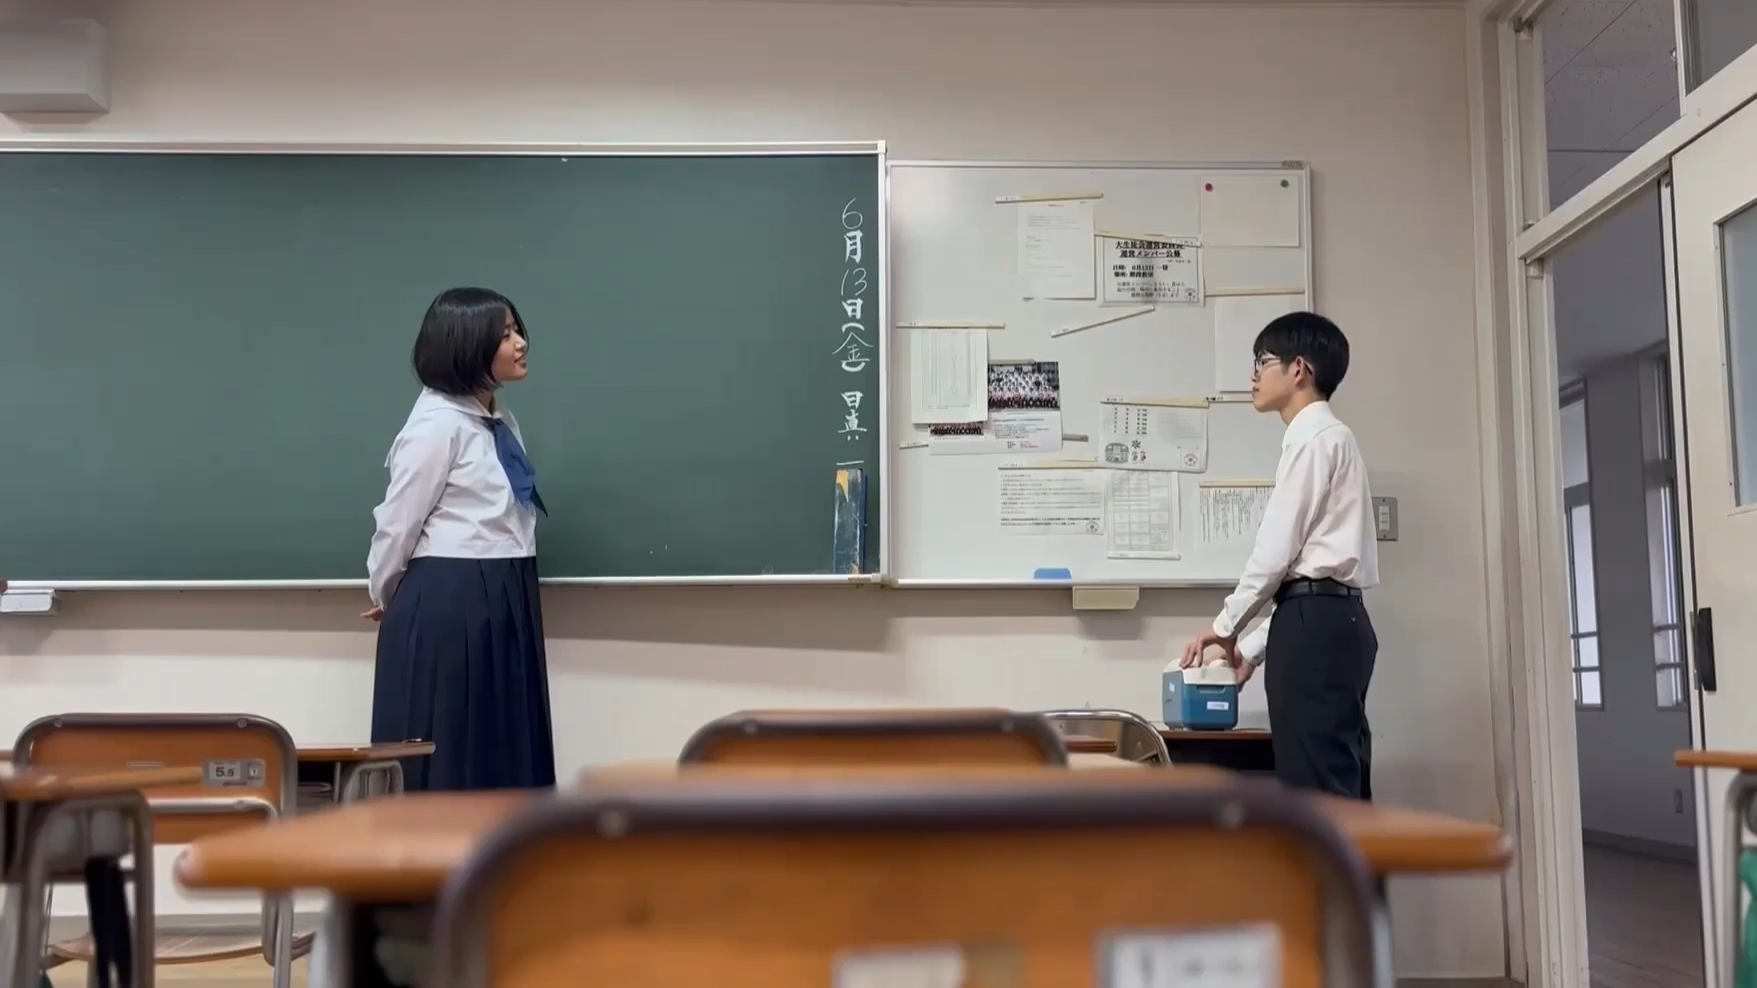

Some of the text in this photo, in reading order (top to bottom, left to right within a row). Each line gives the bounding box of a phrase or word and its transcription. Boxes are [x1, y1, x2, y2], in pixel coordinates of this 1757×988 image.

[832, 198, 874, 372] 6月13日(金)
[216, 766, 234, 778] 5.5
